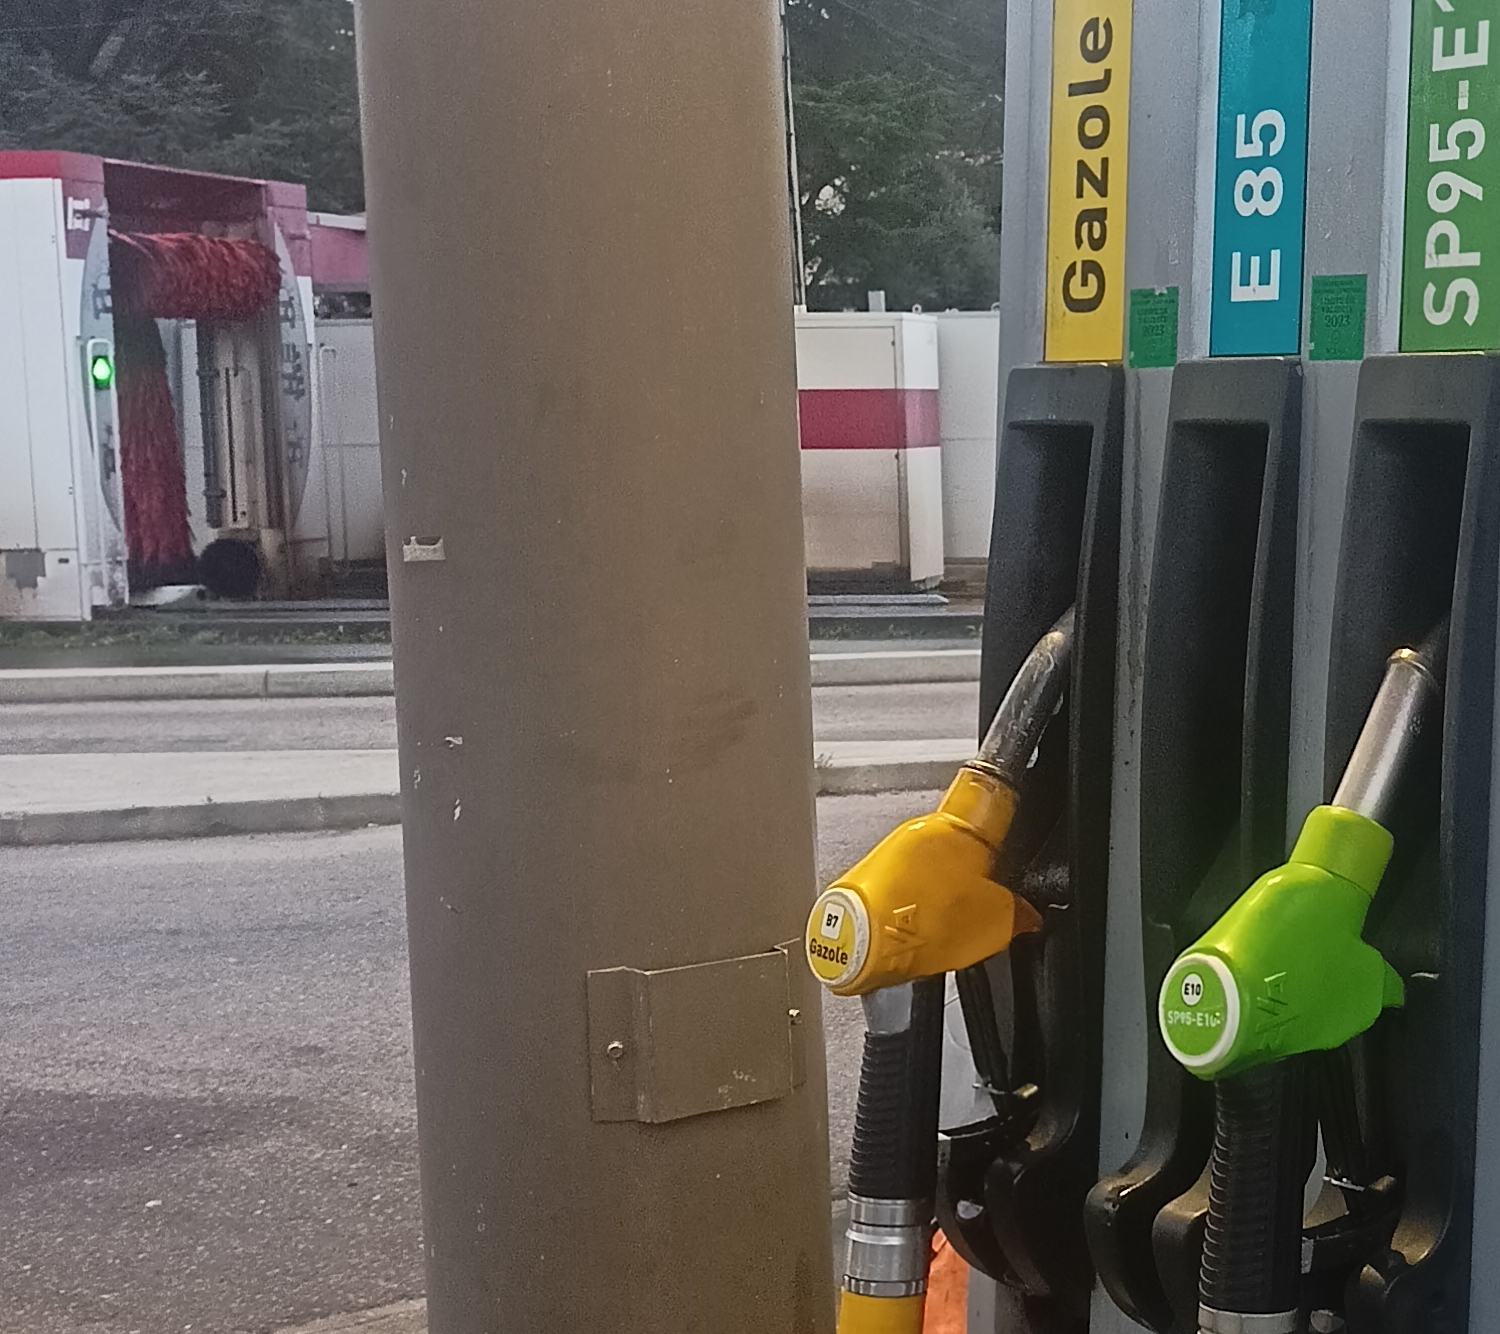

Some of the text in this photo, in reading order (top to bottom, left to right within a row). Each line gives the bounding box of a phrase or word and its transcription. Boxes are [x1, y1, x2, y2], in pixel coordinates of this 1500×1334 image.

[1062, 15, 1114, 314] Gazole
[1230, 108, 1286, 303] E 85
[825, 913, 839, 928] B7
[809, 937, 849, 966] Gazole
[1184, 983, 1201, 996] E10
